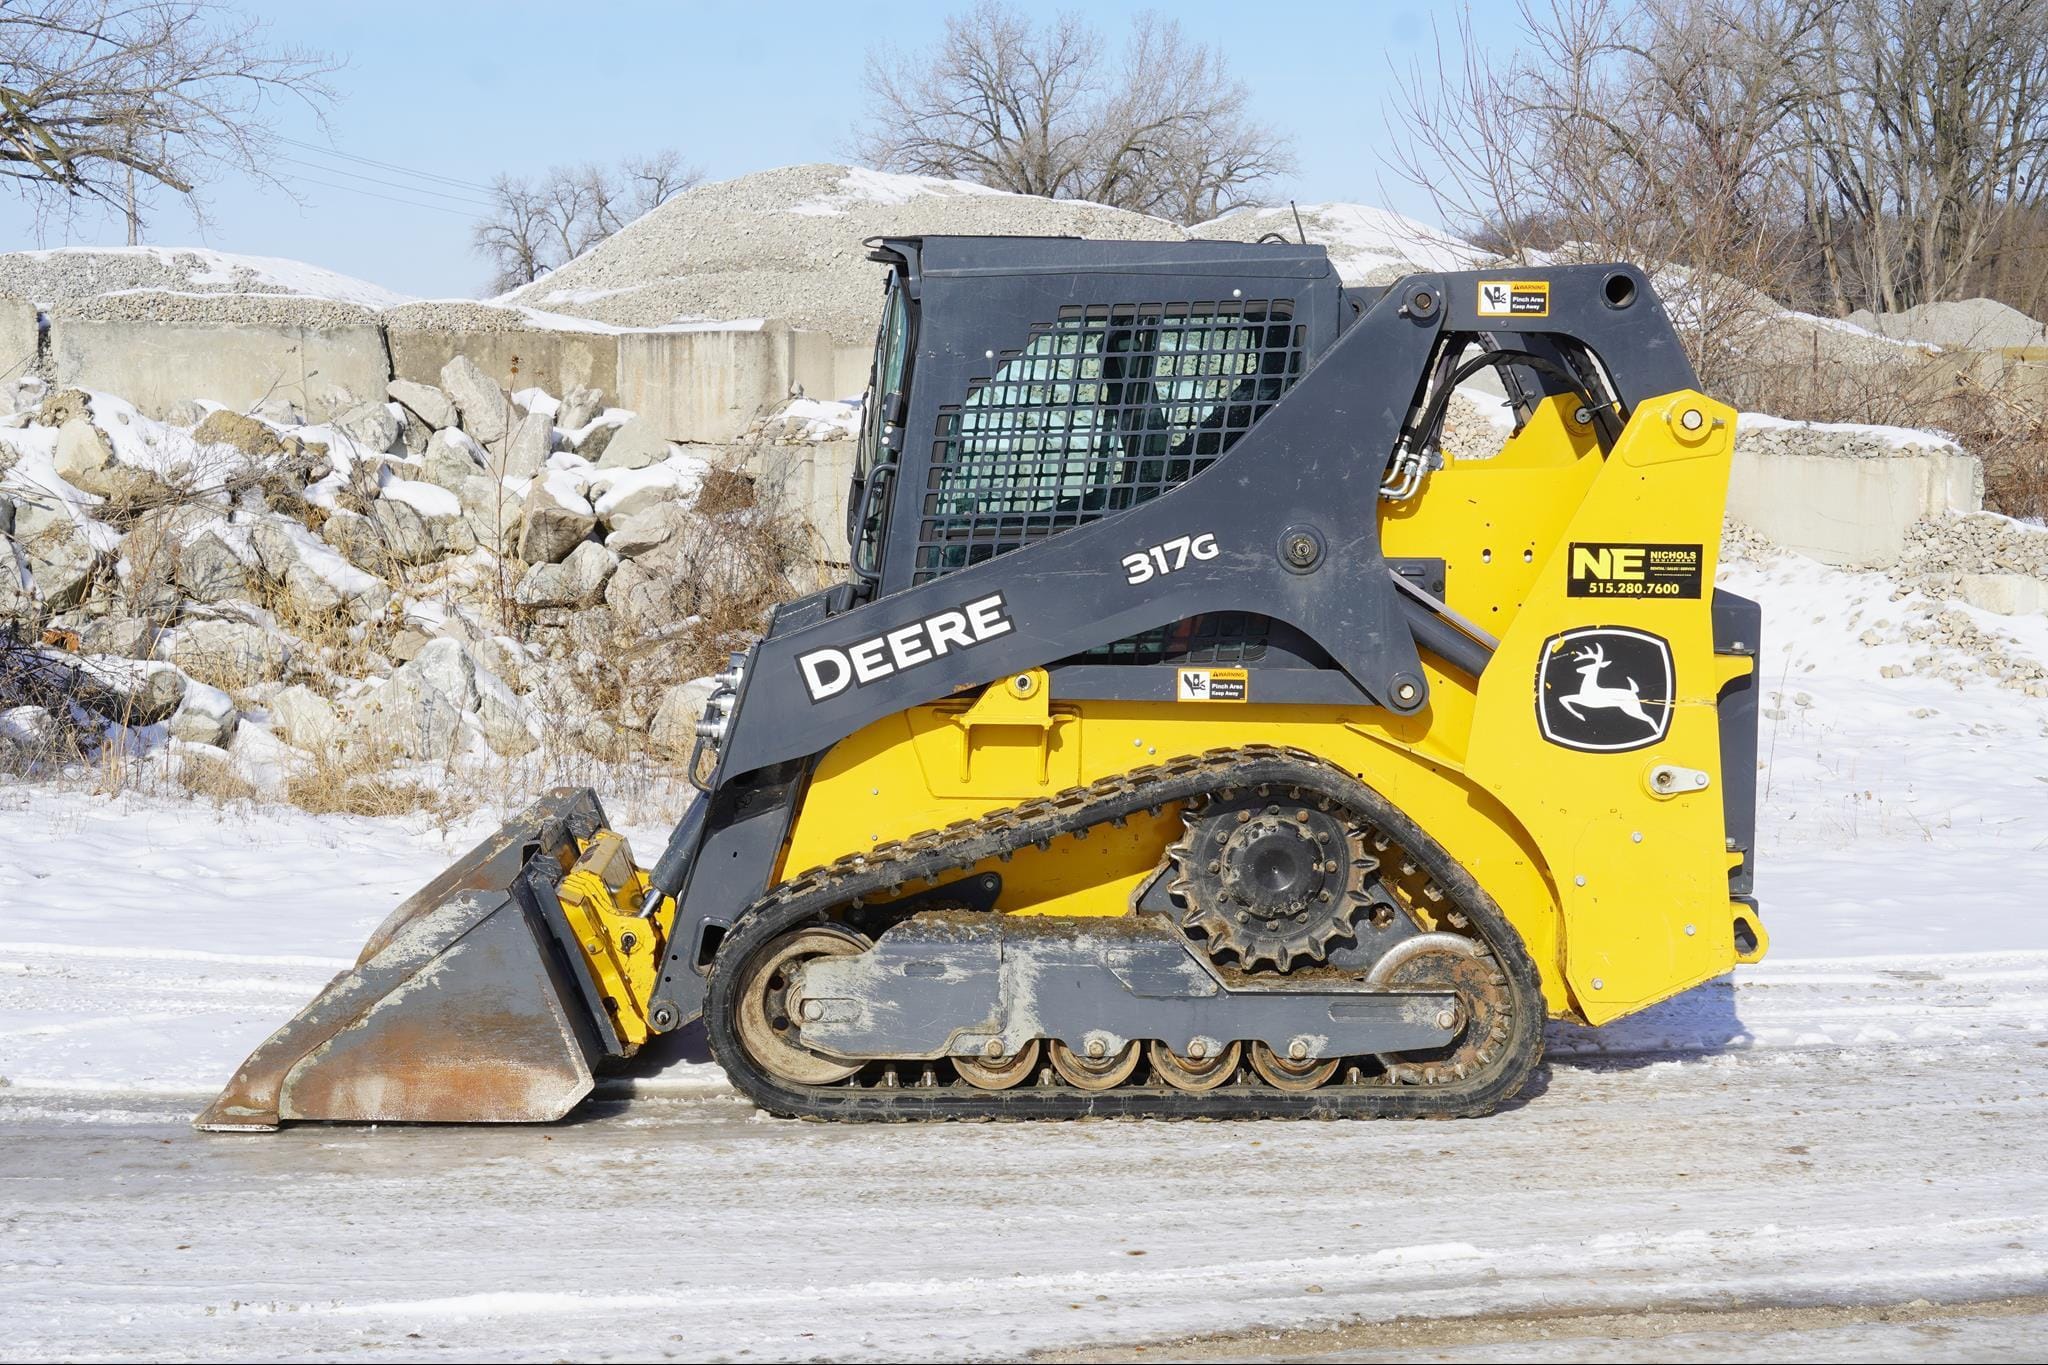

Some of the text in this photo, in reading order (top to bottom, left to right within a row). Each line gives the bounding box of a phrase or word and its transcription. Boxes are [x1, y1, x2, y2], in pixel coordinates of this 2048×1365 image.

[1122, 533, 1219, 584] 317G
[1573, 548, 1645, 580] NE
[1650, 551, 1696, 559] NICHOLS
[1589, 582, 1680, 594] 515.280.7600
[800, 595, 1011, 700] DEERE
